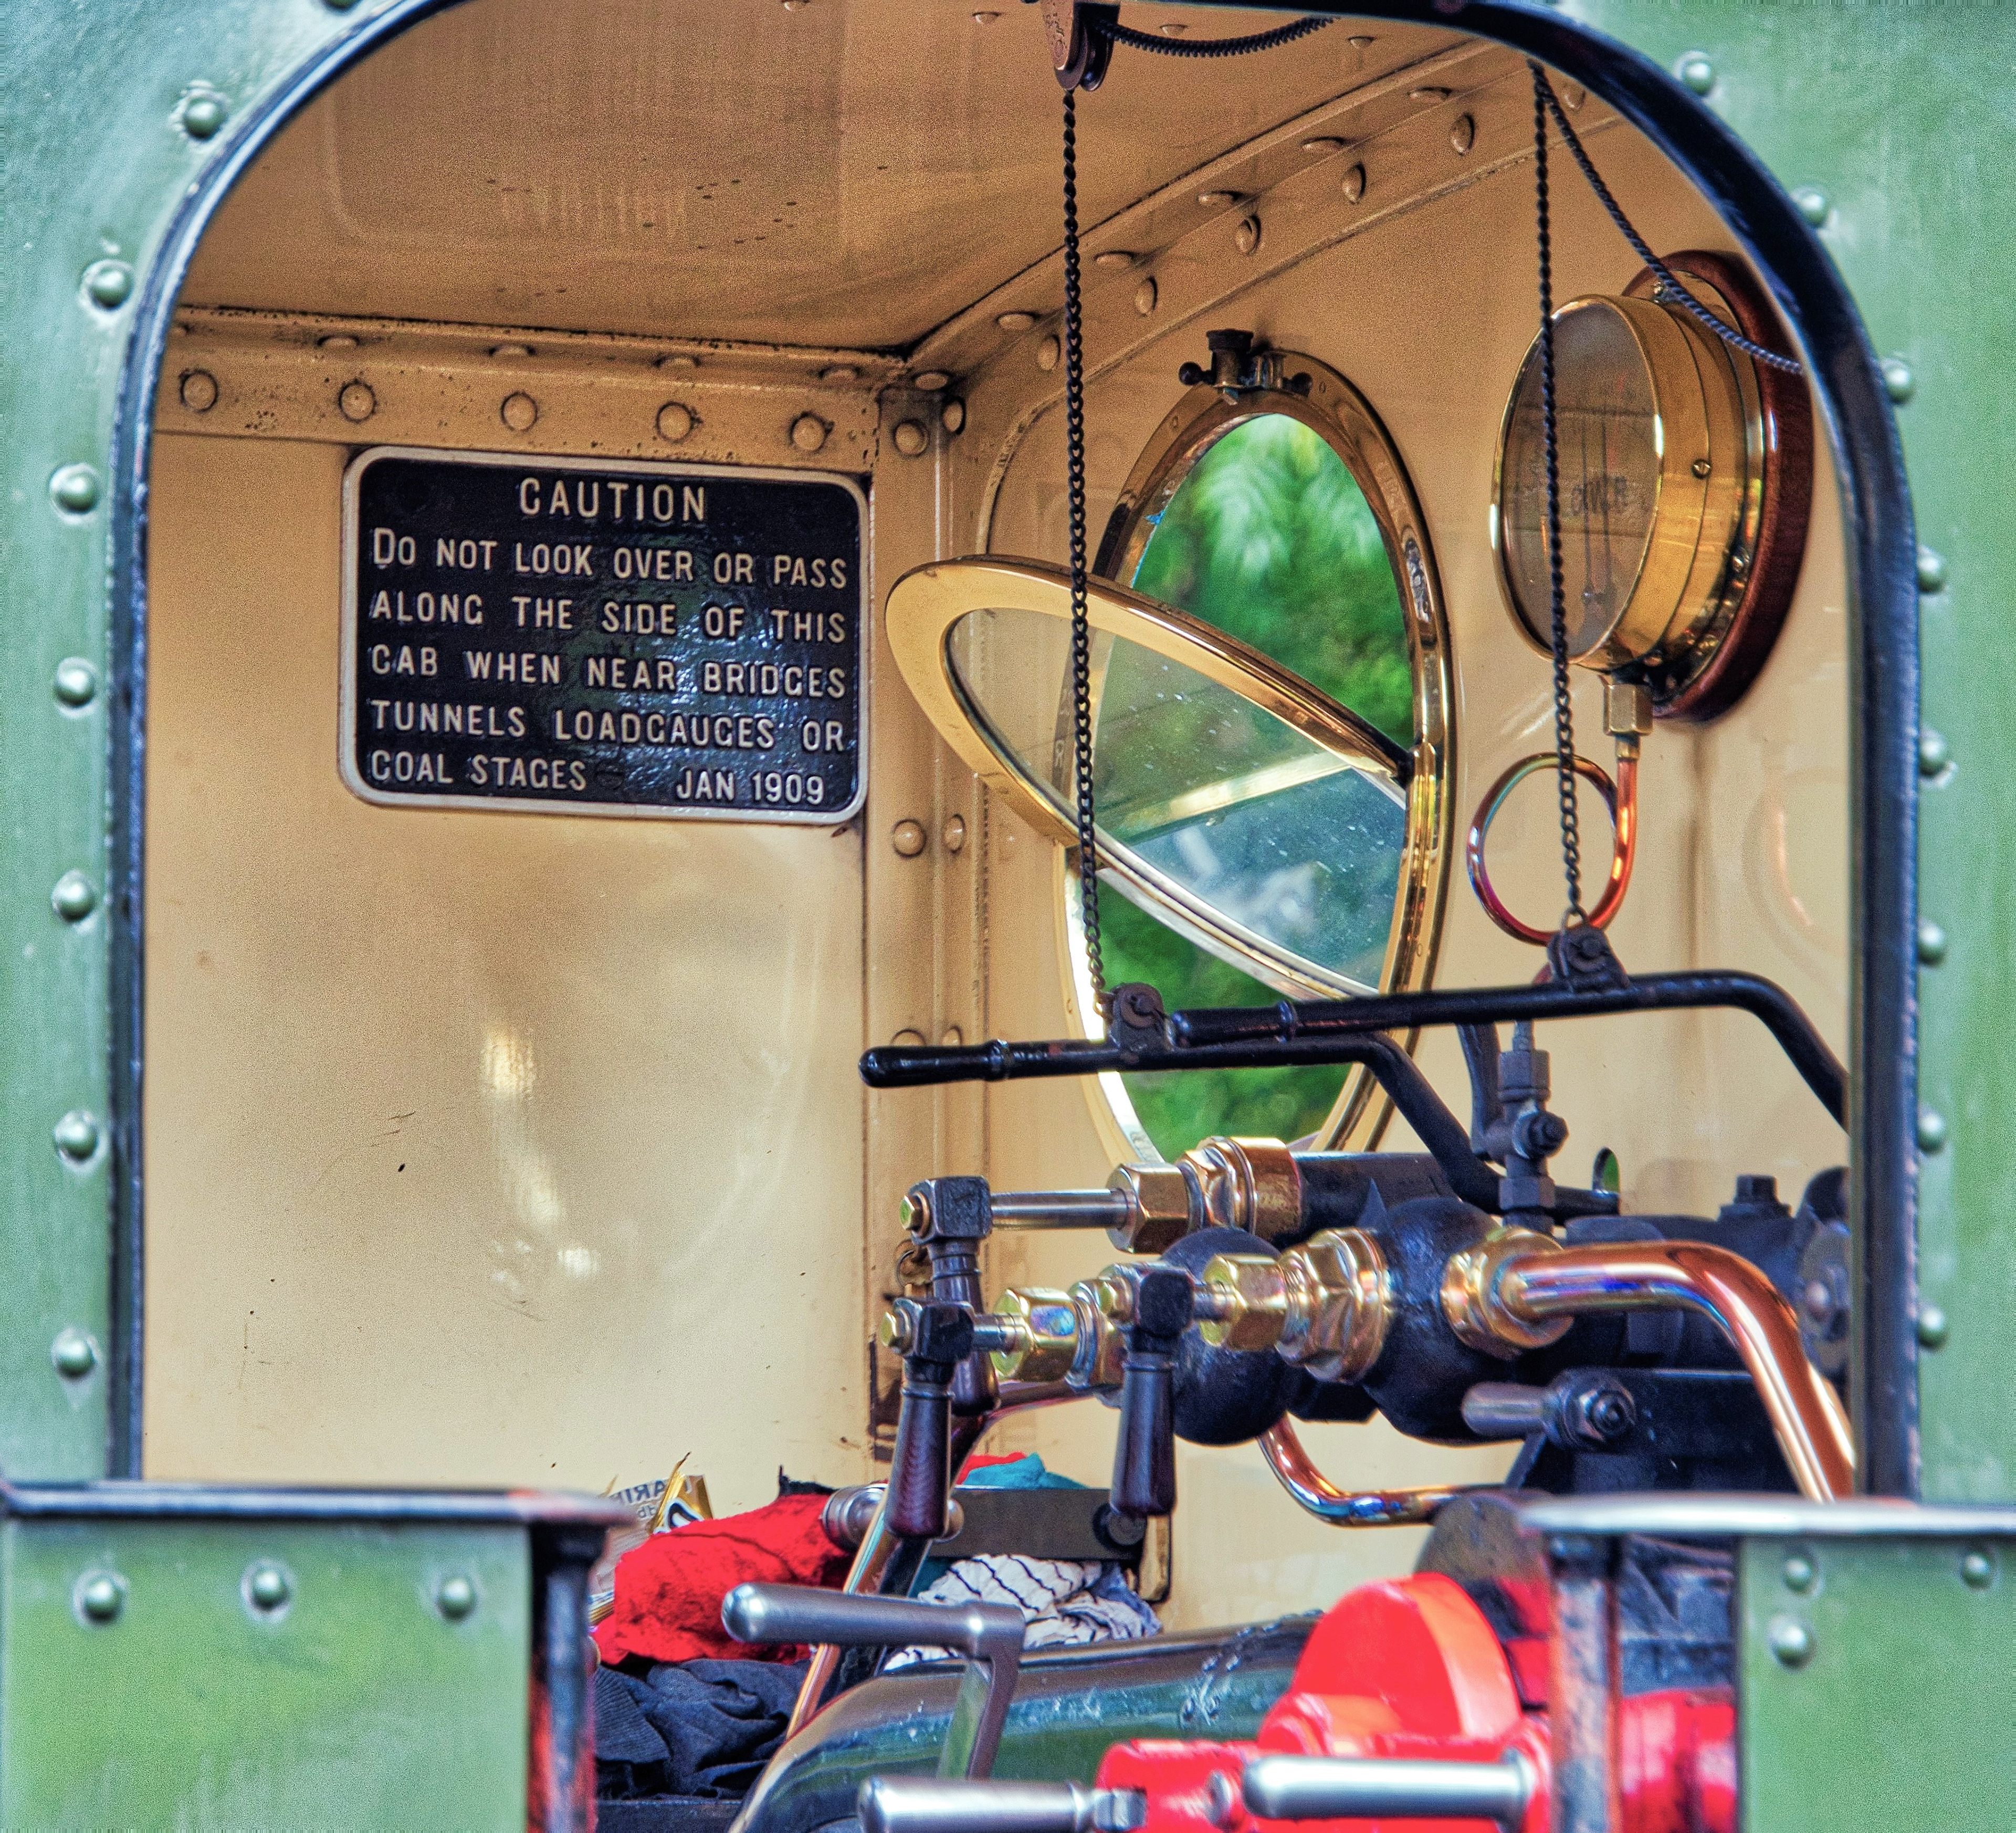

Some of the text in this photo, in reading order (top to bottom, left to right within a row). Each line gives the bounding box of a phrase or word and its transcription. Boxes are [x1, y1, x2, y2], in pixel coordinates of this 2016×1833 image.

[520, 477, 705, 522] CAUTION
[436, 538, 498, 571] NOT
[516, 542, 593, 576] LOOK
[613, 547, 694, 581] OVER
[713, 552, 753, 584] OR
[773, 554, 847, 589] PASS
[372, 590, 846, 643] ALONG THE SIDE OF THIS
[371, 644, 846, 698] CAB WHEN NEAR BRIDGES
[371, 699, 844, 752] TUNNELS LOADGAUGES OR
[371, 749, 824, 805] COAL STAGES JAN 1909
